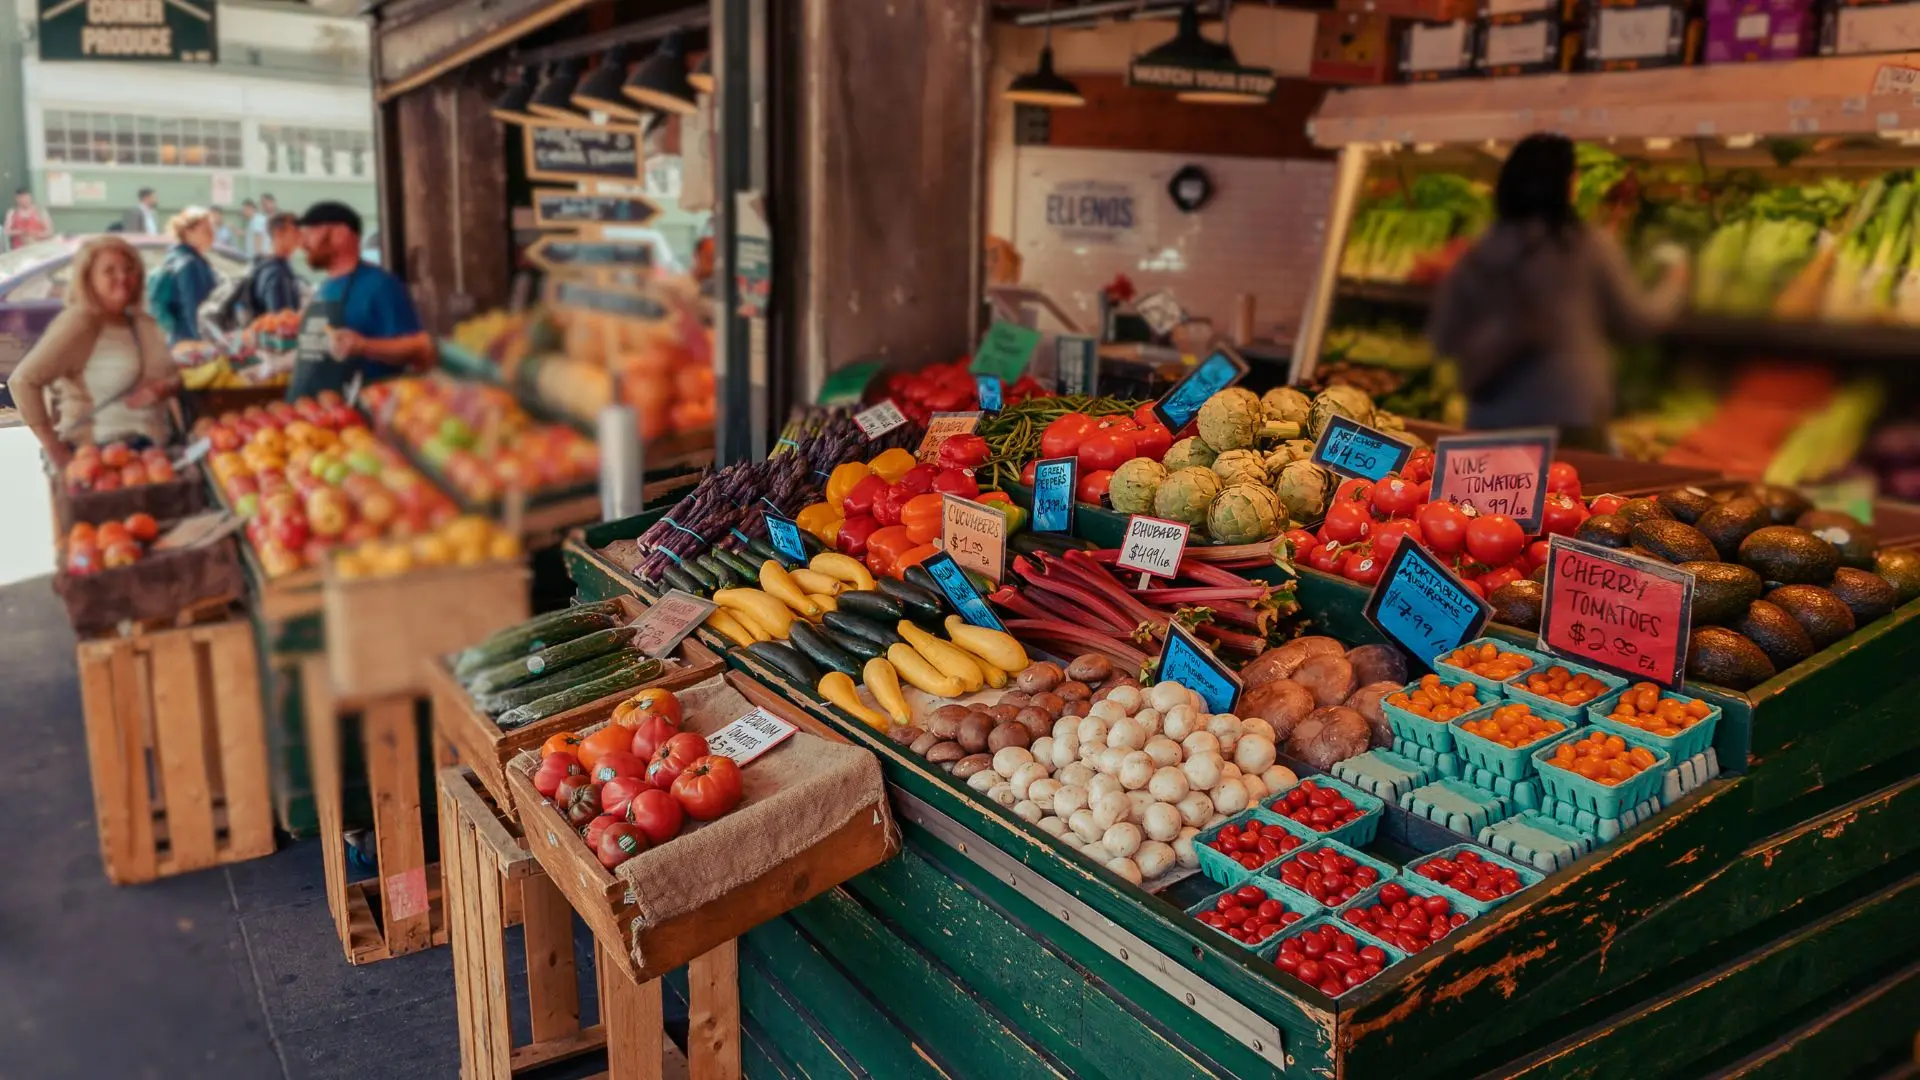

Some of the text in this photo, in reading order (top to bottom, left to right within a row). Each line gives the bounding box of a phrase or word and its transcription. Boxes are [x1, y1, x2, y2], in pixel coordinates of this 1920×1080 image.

[87, 0, 165, 25] CORNER
[81, 26, 173, 56] PRODUCE
[1133, 65, 1276, 94] WATCH YOUR STEP
[1045, 194, 1136, 229] ELLENOS
[1328, 439, 1377, 470] $4.50
[1452, 453, 1491, 475] VINE
[1037, 474, 1067, 490] PEPPERS
[1041, 465, 1065, 477] GREEN
[1462, 473, 1533, 493] TOMATOES
[948, 504, 1000, 538] CUCUMBERS
[1131, 520, 1182, 540] RHUBARB
[1398, 568, 1461, 618] MUSHROOMS
[1406, 553, 1474, 614] PORTABELLO
[1560, 555, 1649, 601] CHERRY
[1565, 588, 1662, 638] TOMATOES
[1174, 639, 1201, 669] BUTTON
[726, 724, 762, 750] TOMATOES
